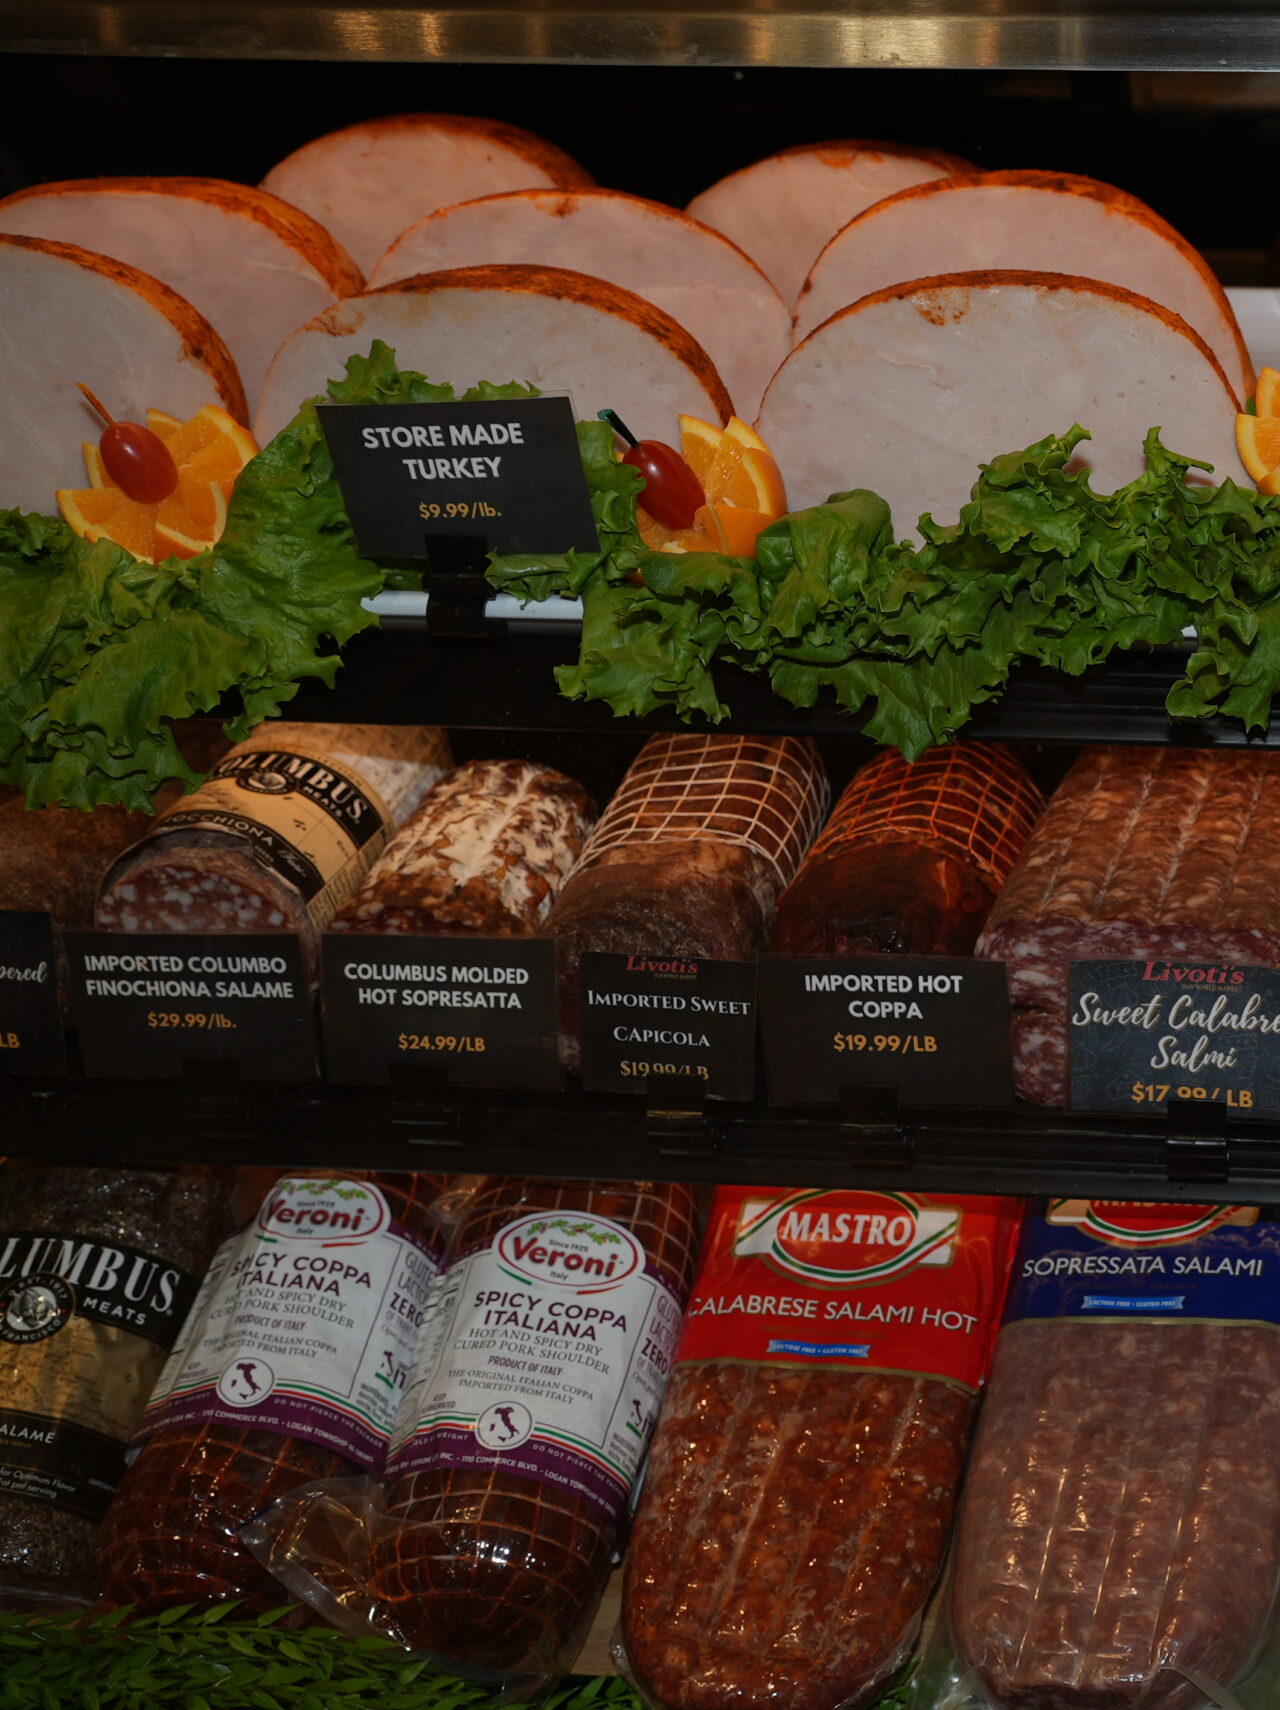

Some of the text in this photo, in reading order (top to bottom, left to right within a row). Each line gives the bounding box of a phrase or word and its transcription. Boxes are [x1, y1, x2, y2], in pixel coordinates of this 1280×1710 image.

[362, 423, 524, 448] STORE MADE
[403, 457, 501, 479] TURKEY
[419, 502, 502, 519] $9.99/lb.
[212, 752, 368, 823] OLUMBUS
[84, 955, 287, 974] IMPORTED COLUMBO
[344, 963, 529, 985] COLUMBUS MOLDED
[86, 980, 294, 998] FINOCHIONA SALAME
[804, 974, 963, 993] IMPORTED HOT
[358, 988, 522, 1009] HOT SOPRESATTA
[848, 1000, 924, 1019] COPPA
[1072, 992, 1163, 1030] Sweet
[147, 1012, 237, 1030] $29.99/lb.
[398, 1033, 486, 1054] $24.99/LB
[833, 1032, 938, 1054] $19.99/LB
[1150, 1034, 1238, 1073] Salmi
[781, 1211, 912, 1247] MASTRO
[513, 1236, 617, 1277] Veroni
[1022, 1255, 1263, 1278] SOPRESSATA SALAMI
[294, 1257, 371, 1288] COPPA
[84, 1297, 147, 1325] MEATS
[283, 1303, 354, 1329] SHOULDER
[474, 1291, 627, 1332] SPICY COPPA
[824, 1301, 914, 1324] SALAMI
[921, 1308, 978, 1333] HOT
[484, 1310, 596, 1341] ITALIANA
[469, 1328, 602, 1357] HOT AND SPICY DRY
[453, 1340, 610, 1374] CURED PORK SHOULDER
